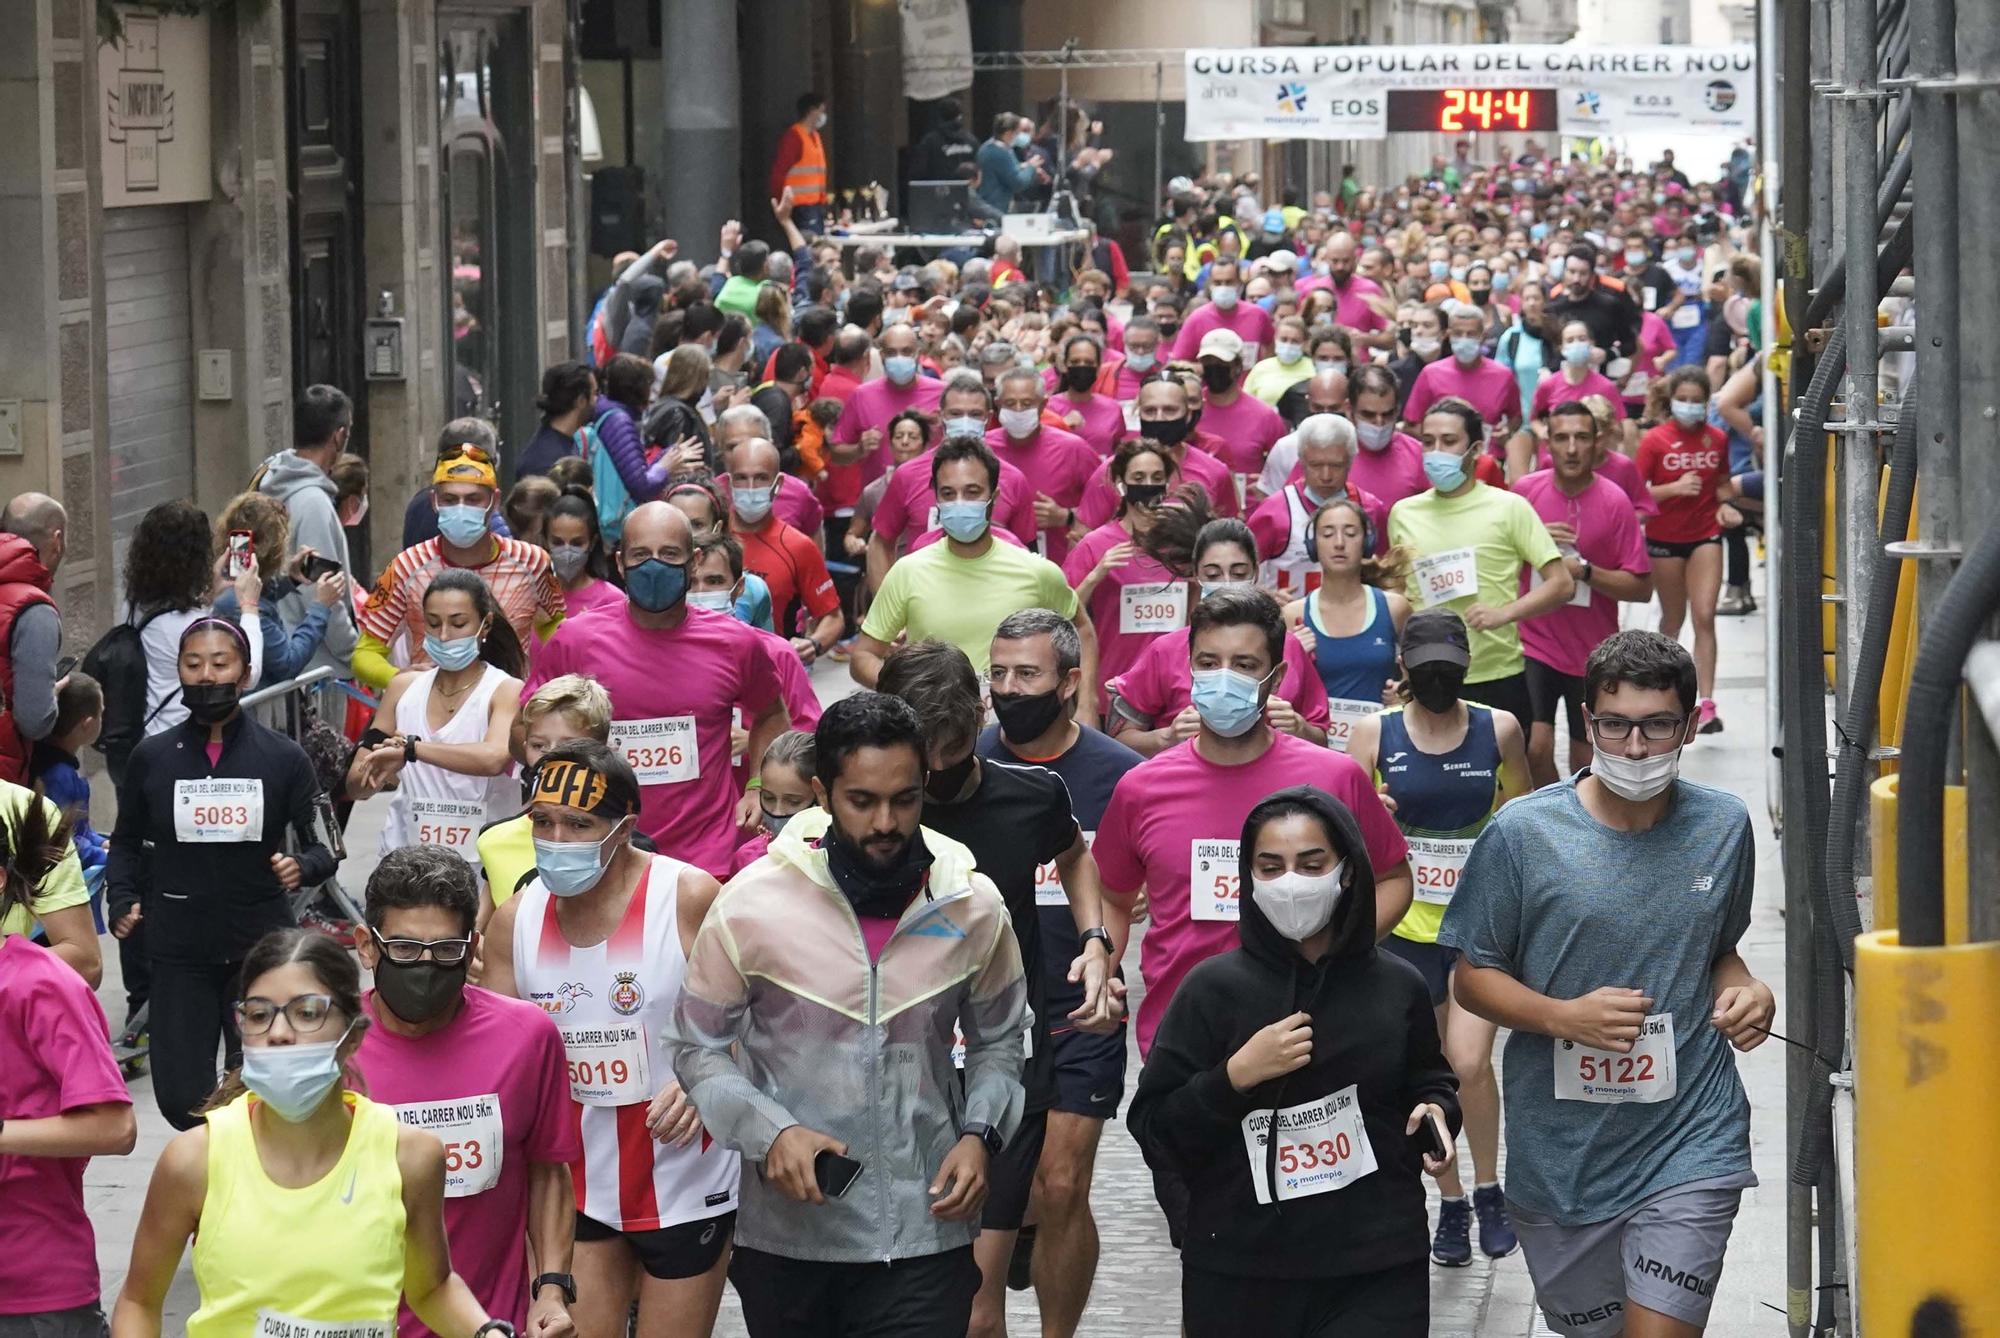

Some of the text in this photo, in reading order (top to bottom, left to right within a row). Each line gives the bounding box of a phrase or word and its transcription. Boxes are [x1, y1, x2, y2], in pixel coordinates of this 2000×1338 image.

[1194, 53, 1751, 74] CURSA POPULAR DEL CARRER NOU
[1331, 100, 1379, 116] EOS
[1430, 570, 1465, 592] 5308
[1134, 604, 1175, 620] 5309
[629, 725, 640, 736] DEL
[641, 723, 663, 734] CARRER
[664, 722, 677, 733] NOU
[627, 746, 683, 768] 5326
[194, 806, 247, 825] 5083
[419, 825, 471, 845] 5157
[1198, 845, 1219, 858] CURSA
[1221, 845, 1234, 858] DEL
[562, 1029, 637, 1044] DEL CARRER NOU 5Km
[1649, 1022, 1666, 1035] 5Km
[567, 1059, 628, 1085] 5019
[1579, 1054, 1655, 1083] 5122
[580, 1088, 613, 1097] montepio
[1595, 1086, 1637, 1095] montepio
[403, 1109, 420, 1124] DEL
[421, 1107, 455, 1124] CARRER
[456, 1105, 474, 1120] NOU
[476, 1102, 493, 1118] 5Km
[1277, 1115, 1291, 1128] DEL
[1292, 1107, 1325, 1128] CARRER
[1324, 1099, 1337, 1118] NOU
[1337, 1094, 1352, 1111] 5Km
[1279, 1132, 1351, 1173] 5330
[1300, 1169, 1343, 1183] montepio
[264, 1317, 291, 1338] CURSA
